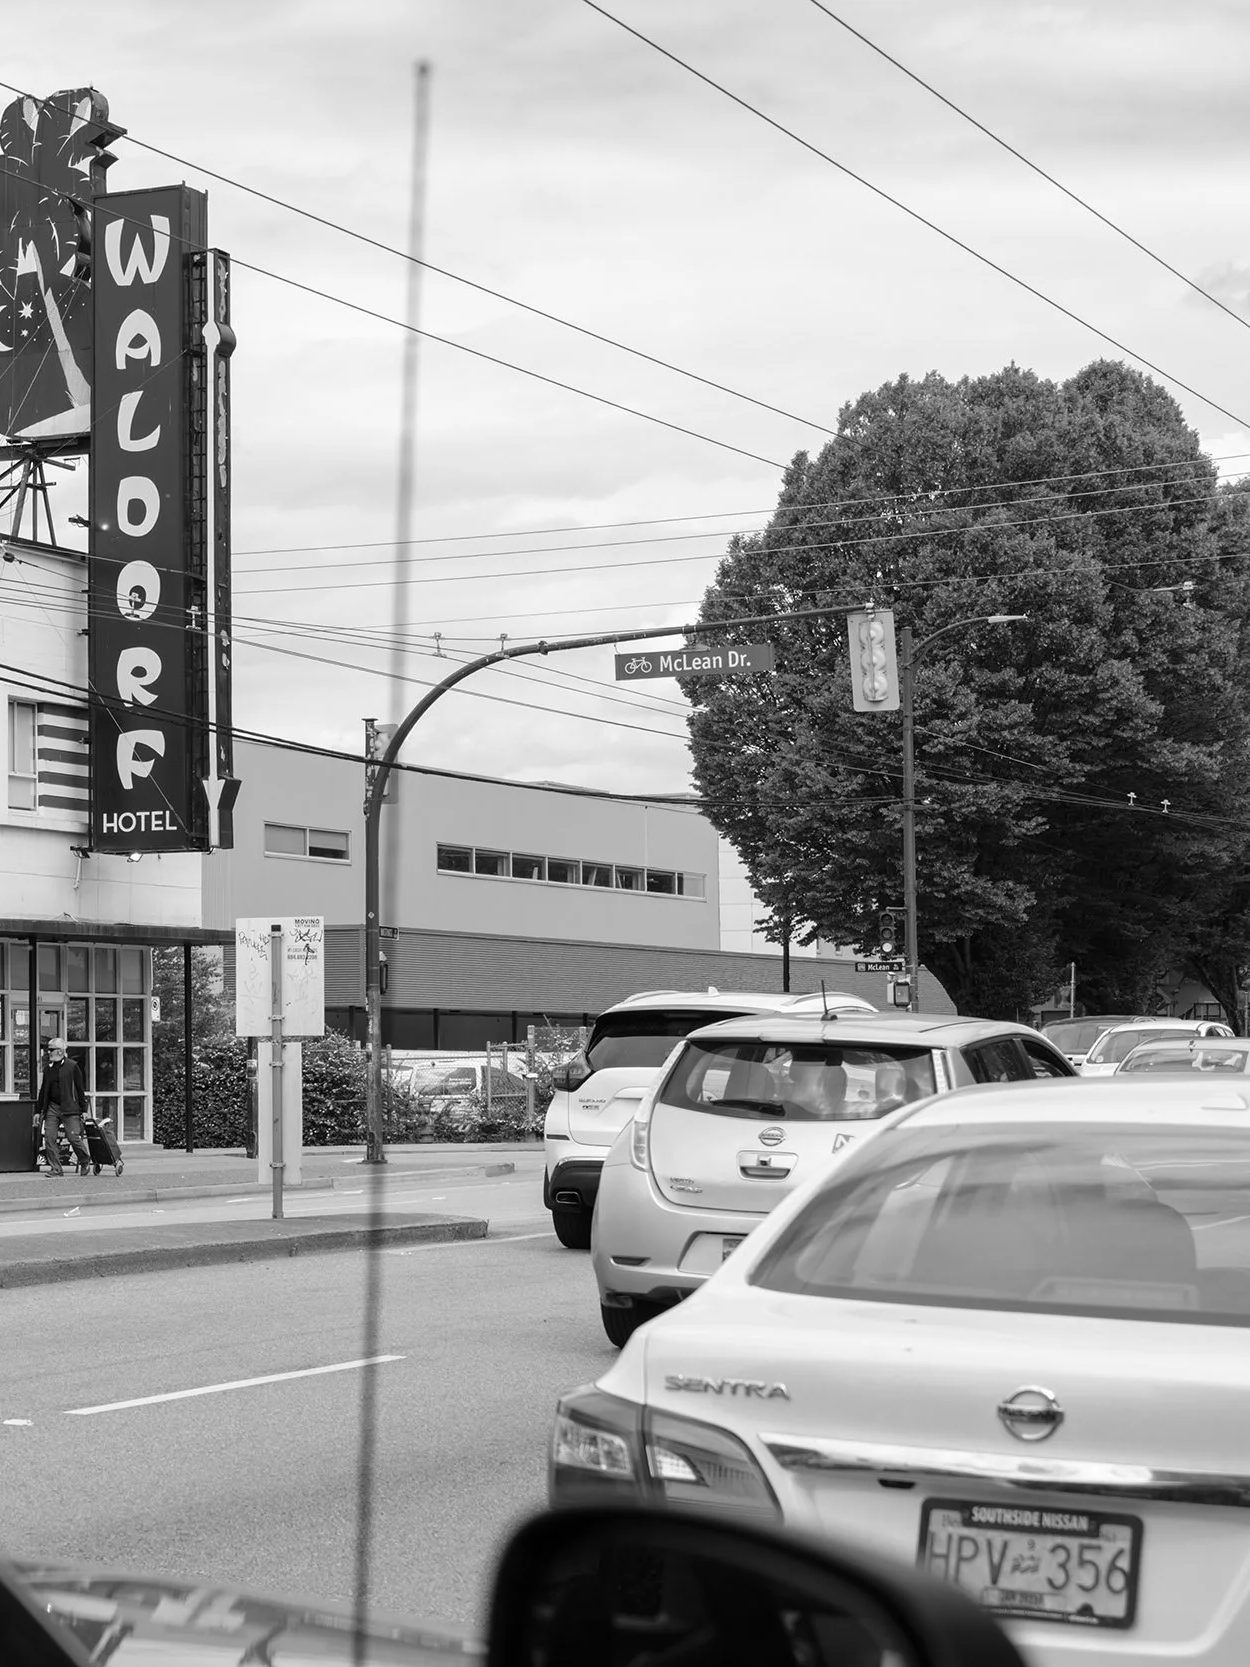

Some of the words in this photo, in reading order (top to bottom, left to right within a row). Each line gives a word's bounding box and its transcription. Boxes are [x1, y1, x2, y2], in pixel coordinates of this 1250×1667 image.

[105, 214, 170, 790] WALDORF
[659, 654, 723, 672] McLean
[728, 651, 752, 668] Dr.
[103, 810, 177, 833] HOTEL
[664, 1375, 792, 1401] SENTRA
[971, 1506, 1040, 1527] SOUTHSIDE
[1042, 1512, 1089, 1531] NISSAN
[928, 1530, 1008, 1586] HPV
[1047, 1543, 1129, 1594] 356
